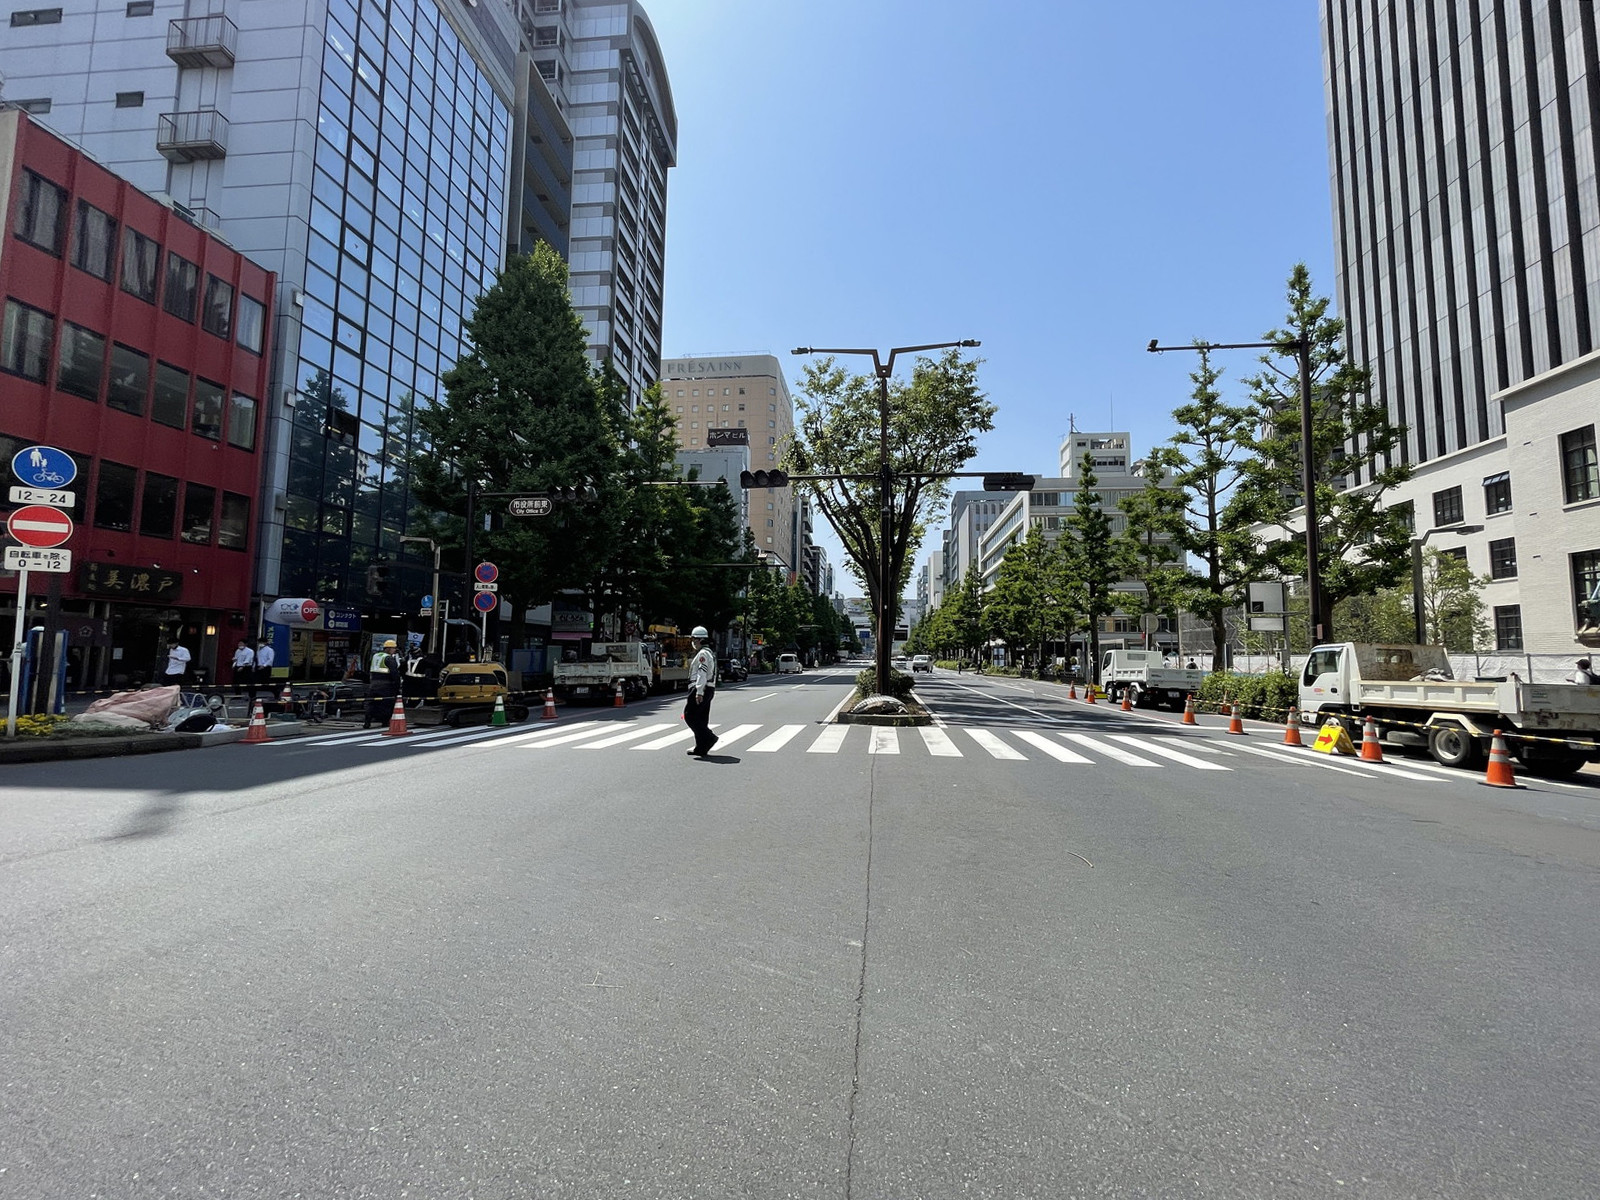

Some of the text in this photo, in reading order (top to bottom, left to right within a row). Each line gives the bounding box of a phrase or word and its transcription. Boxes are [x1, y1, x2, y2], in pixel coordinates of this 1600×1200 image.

[667, 361, 743, 373] FRÉSA INN
[709, 431, 746, 439] ホンマビル
[513, 500, 548, 509] 市役所前東
[103, 569, 174, 592] 美濃戸
